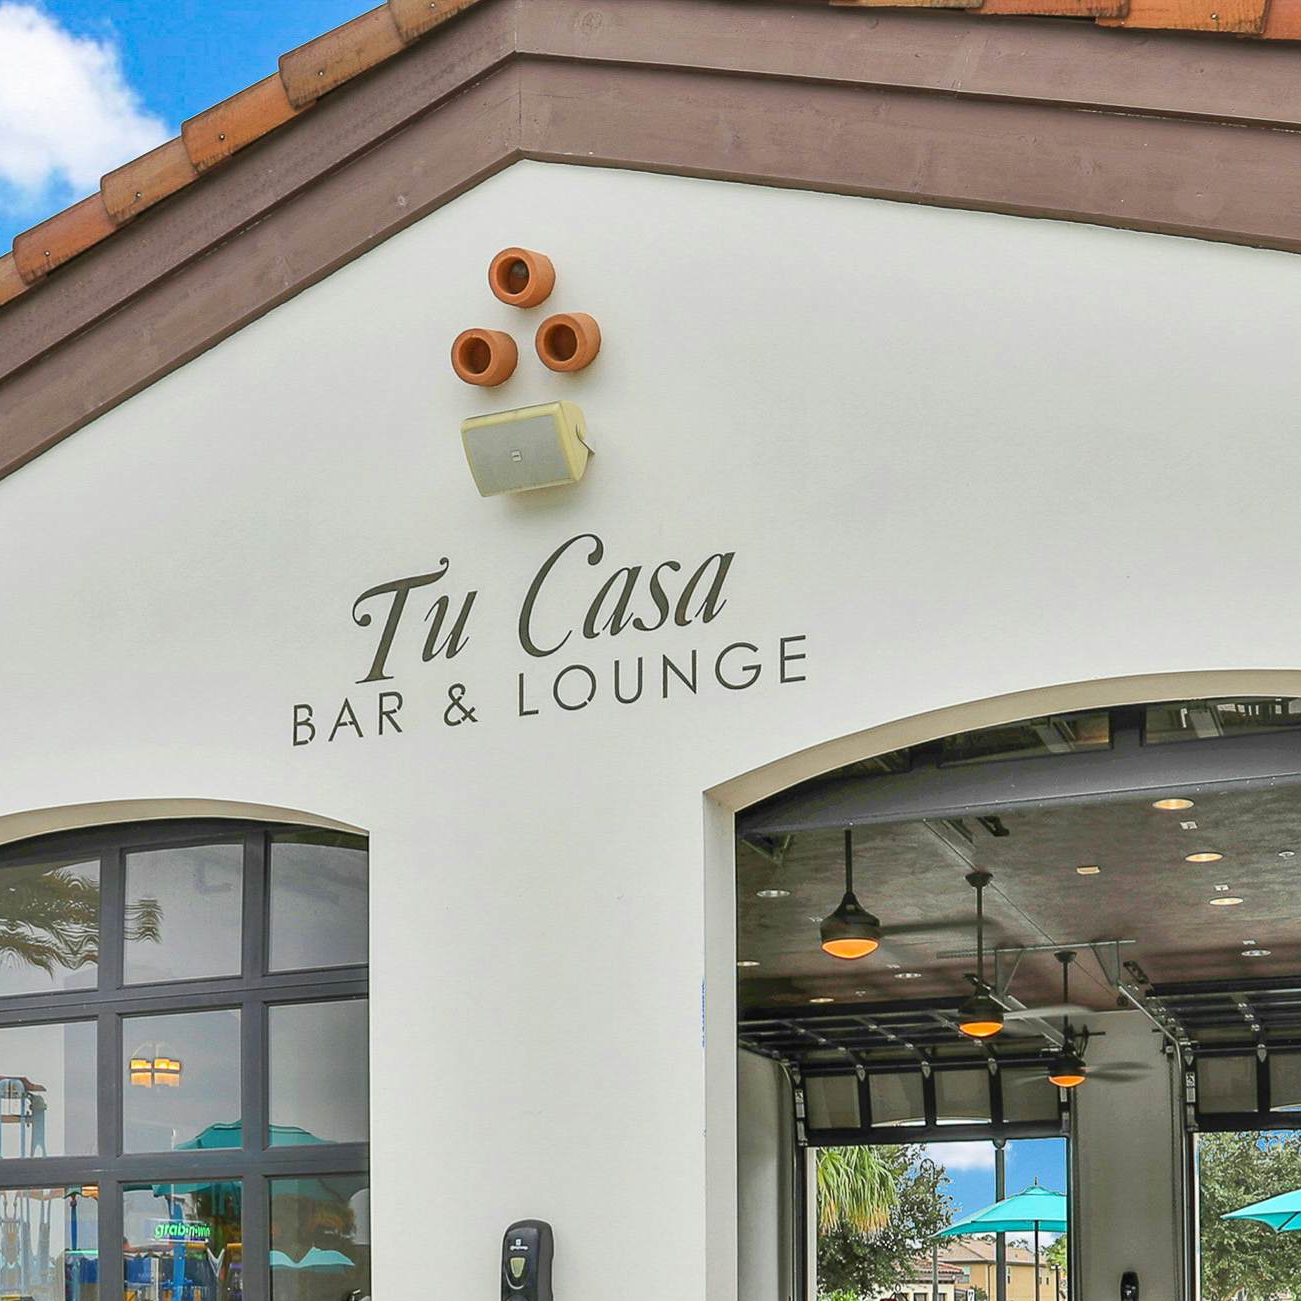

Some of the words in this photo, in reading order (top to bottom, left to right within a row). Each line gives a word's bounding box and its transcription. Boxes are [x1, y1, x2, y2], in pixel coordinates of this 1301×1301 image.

[352, 556, 478, 684] Tu
[518, 533, 736, 658] Casa
[292, 690, 404, 747] BAR
[443, 682, 479, 727] &
[517, 634, 807, 717] LOUNGE
